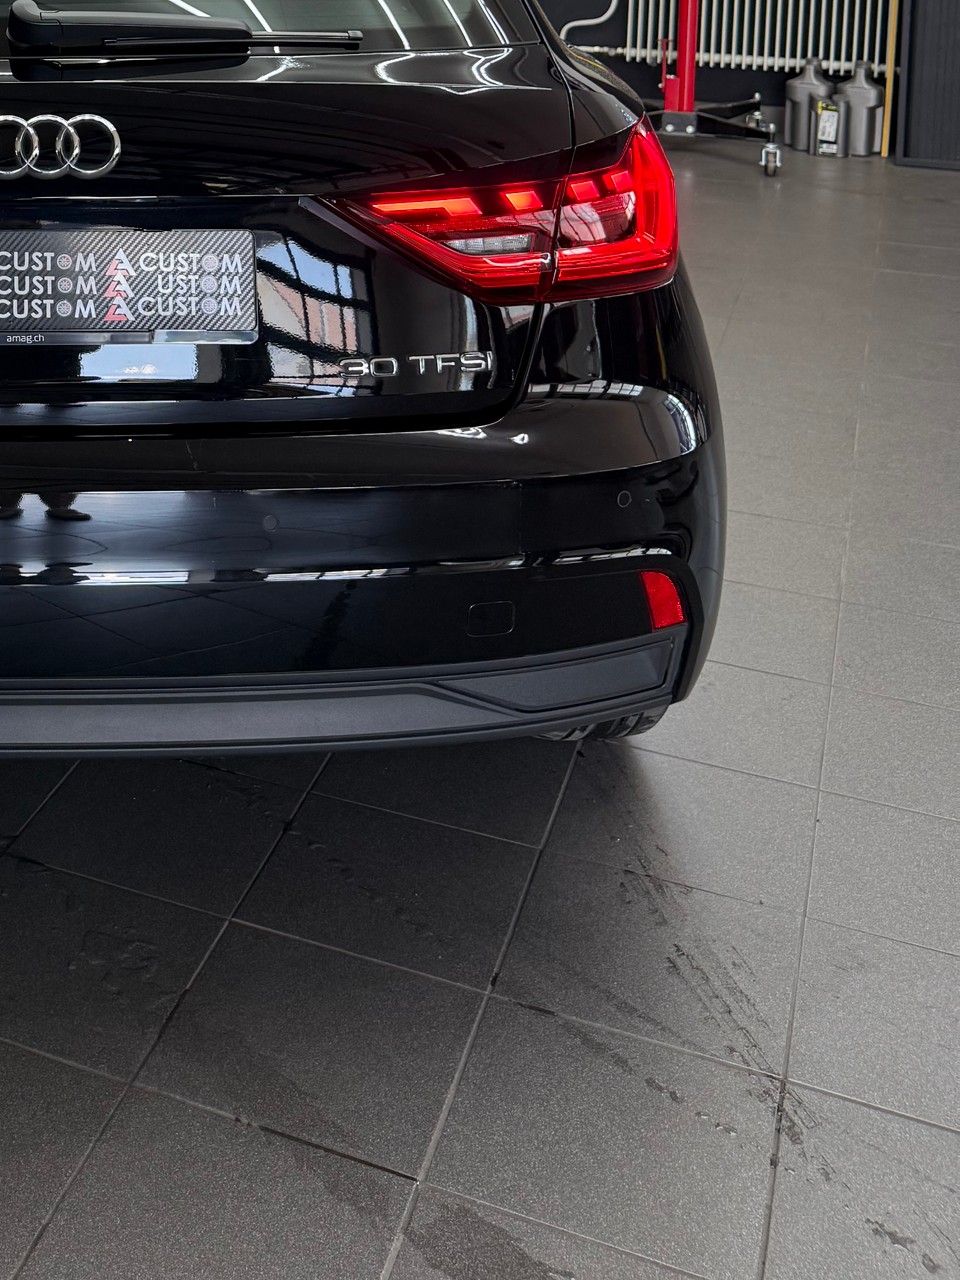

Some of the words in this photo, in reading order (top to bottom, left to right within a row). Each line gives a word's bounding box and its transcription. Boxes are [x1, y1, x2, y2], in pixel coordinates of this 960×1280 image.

[139, 253, 243, 272] CUSTOM
[137, 297, 241, 316] CUSTOM
[6, 334, 45, 344] amag.ch
[339, 357, 398, 378] 30
[408, 351, 494, 375] TFSI
